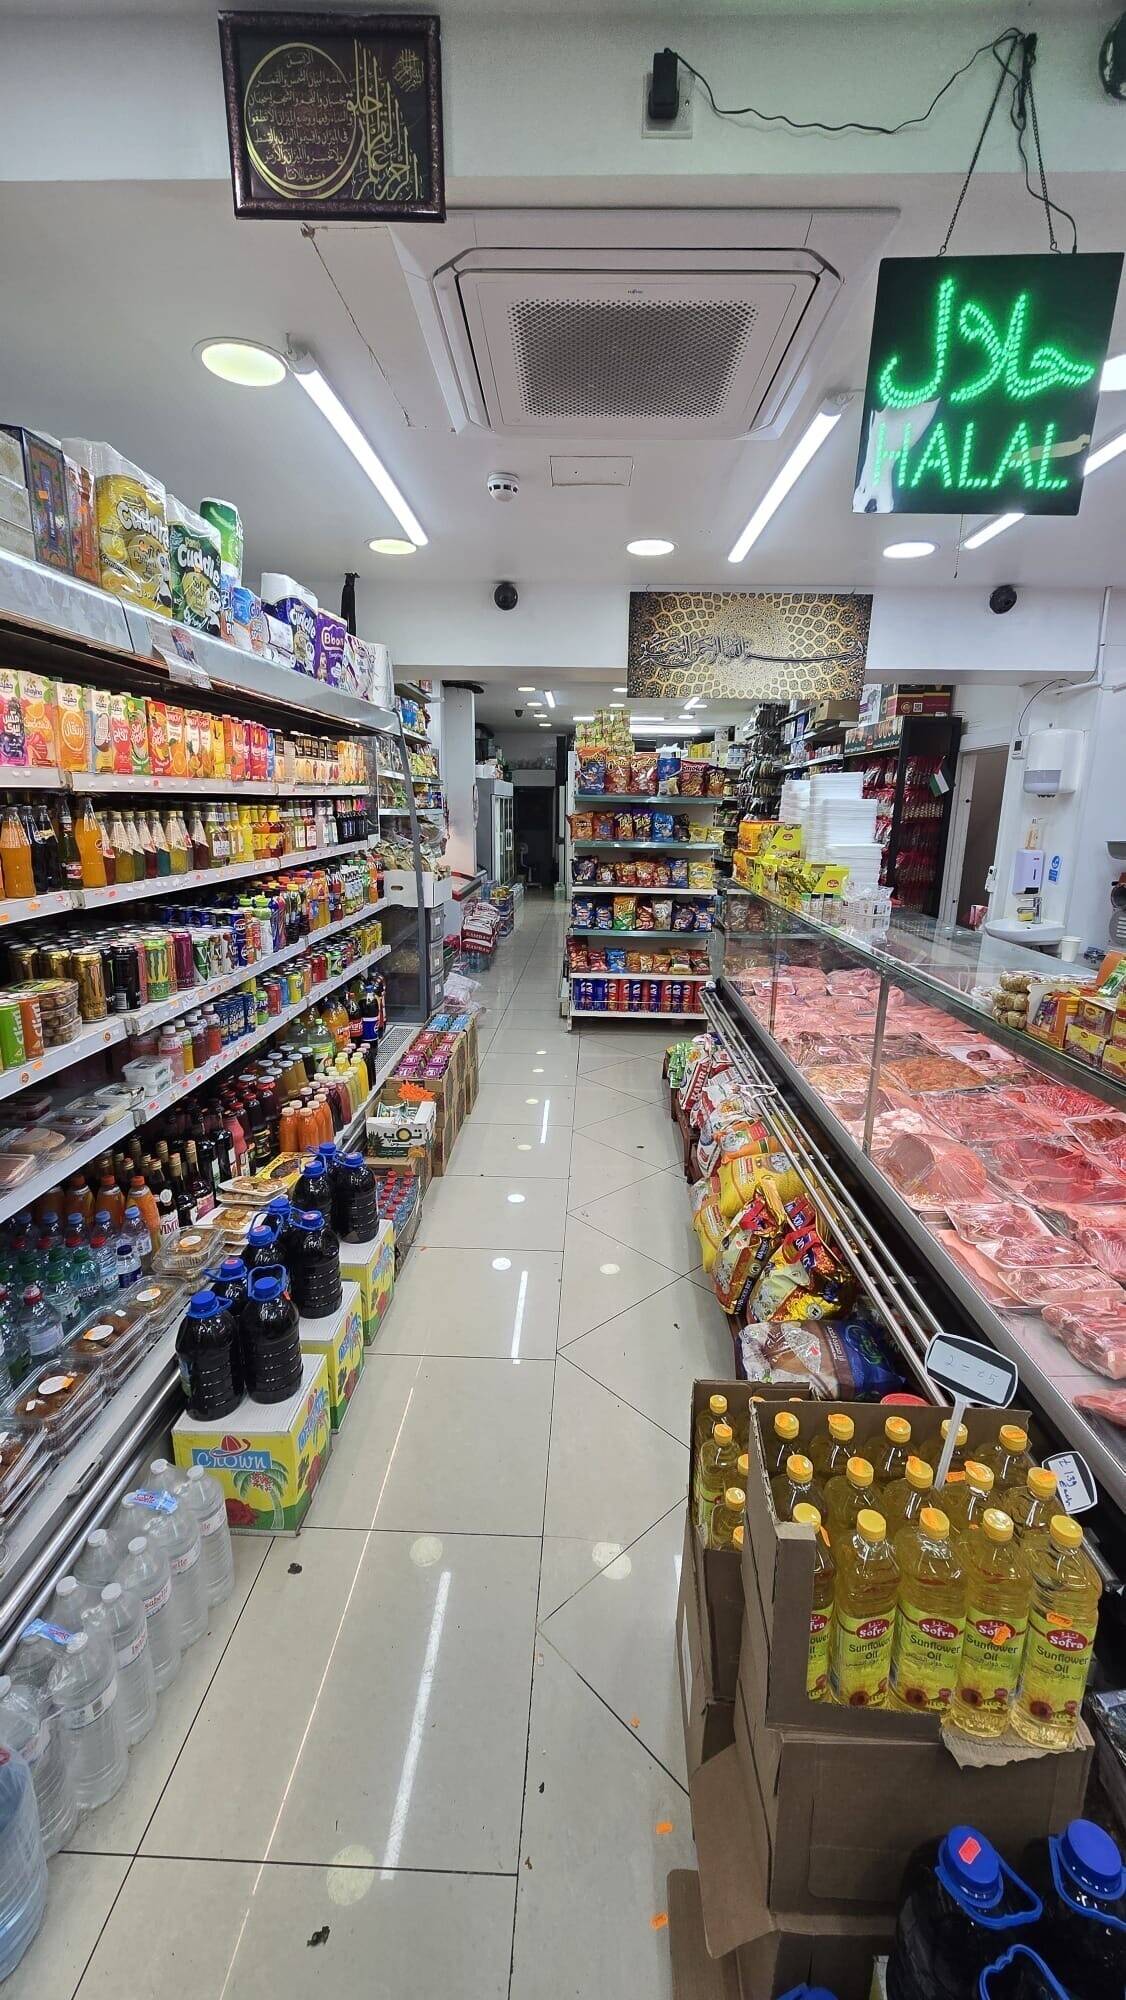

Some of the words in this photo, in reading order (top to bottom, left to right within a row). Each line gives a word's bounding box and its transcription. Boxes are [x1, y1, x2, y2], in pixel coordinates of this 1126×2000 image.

[879, 278, 1096, 409] حلال
[872, 421, 1068, 489] HALAL
[177, 543, 220, 588] Cuddle
[197, 1452, 267, 1469] Crown
[860, 1625, 888, 1640] Sofra
[921, 1623, 956, 1639] Sofra
[910, 1634, 961, 1654] Sunflower
[966, 1634, 1019, 1654] Sunflower
[1049, 1635, 1084, 1650] Sofra
[865, 1651, 878, 1661] Oil
[927, 1651, 942, 1661] Oil
[983, 1652, 998, 1662] Oil
[1036, 1645, 1089, 1665] Sunflower
[1053, 1663, 1070, 1674] Oil
